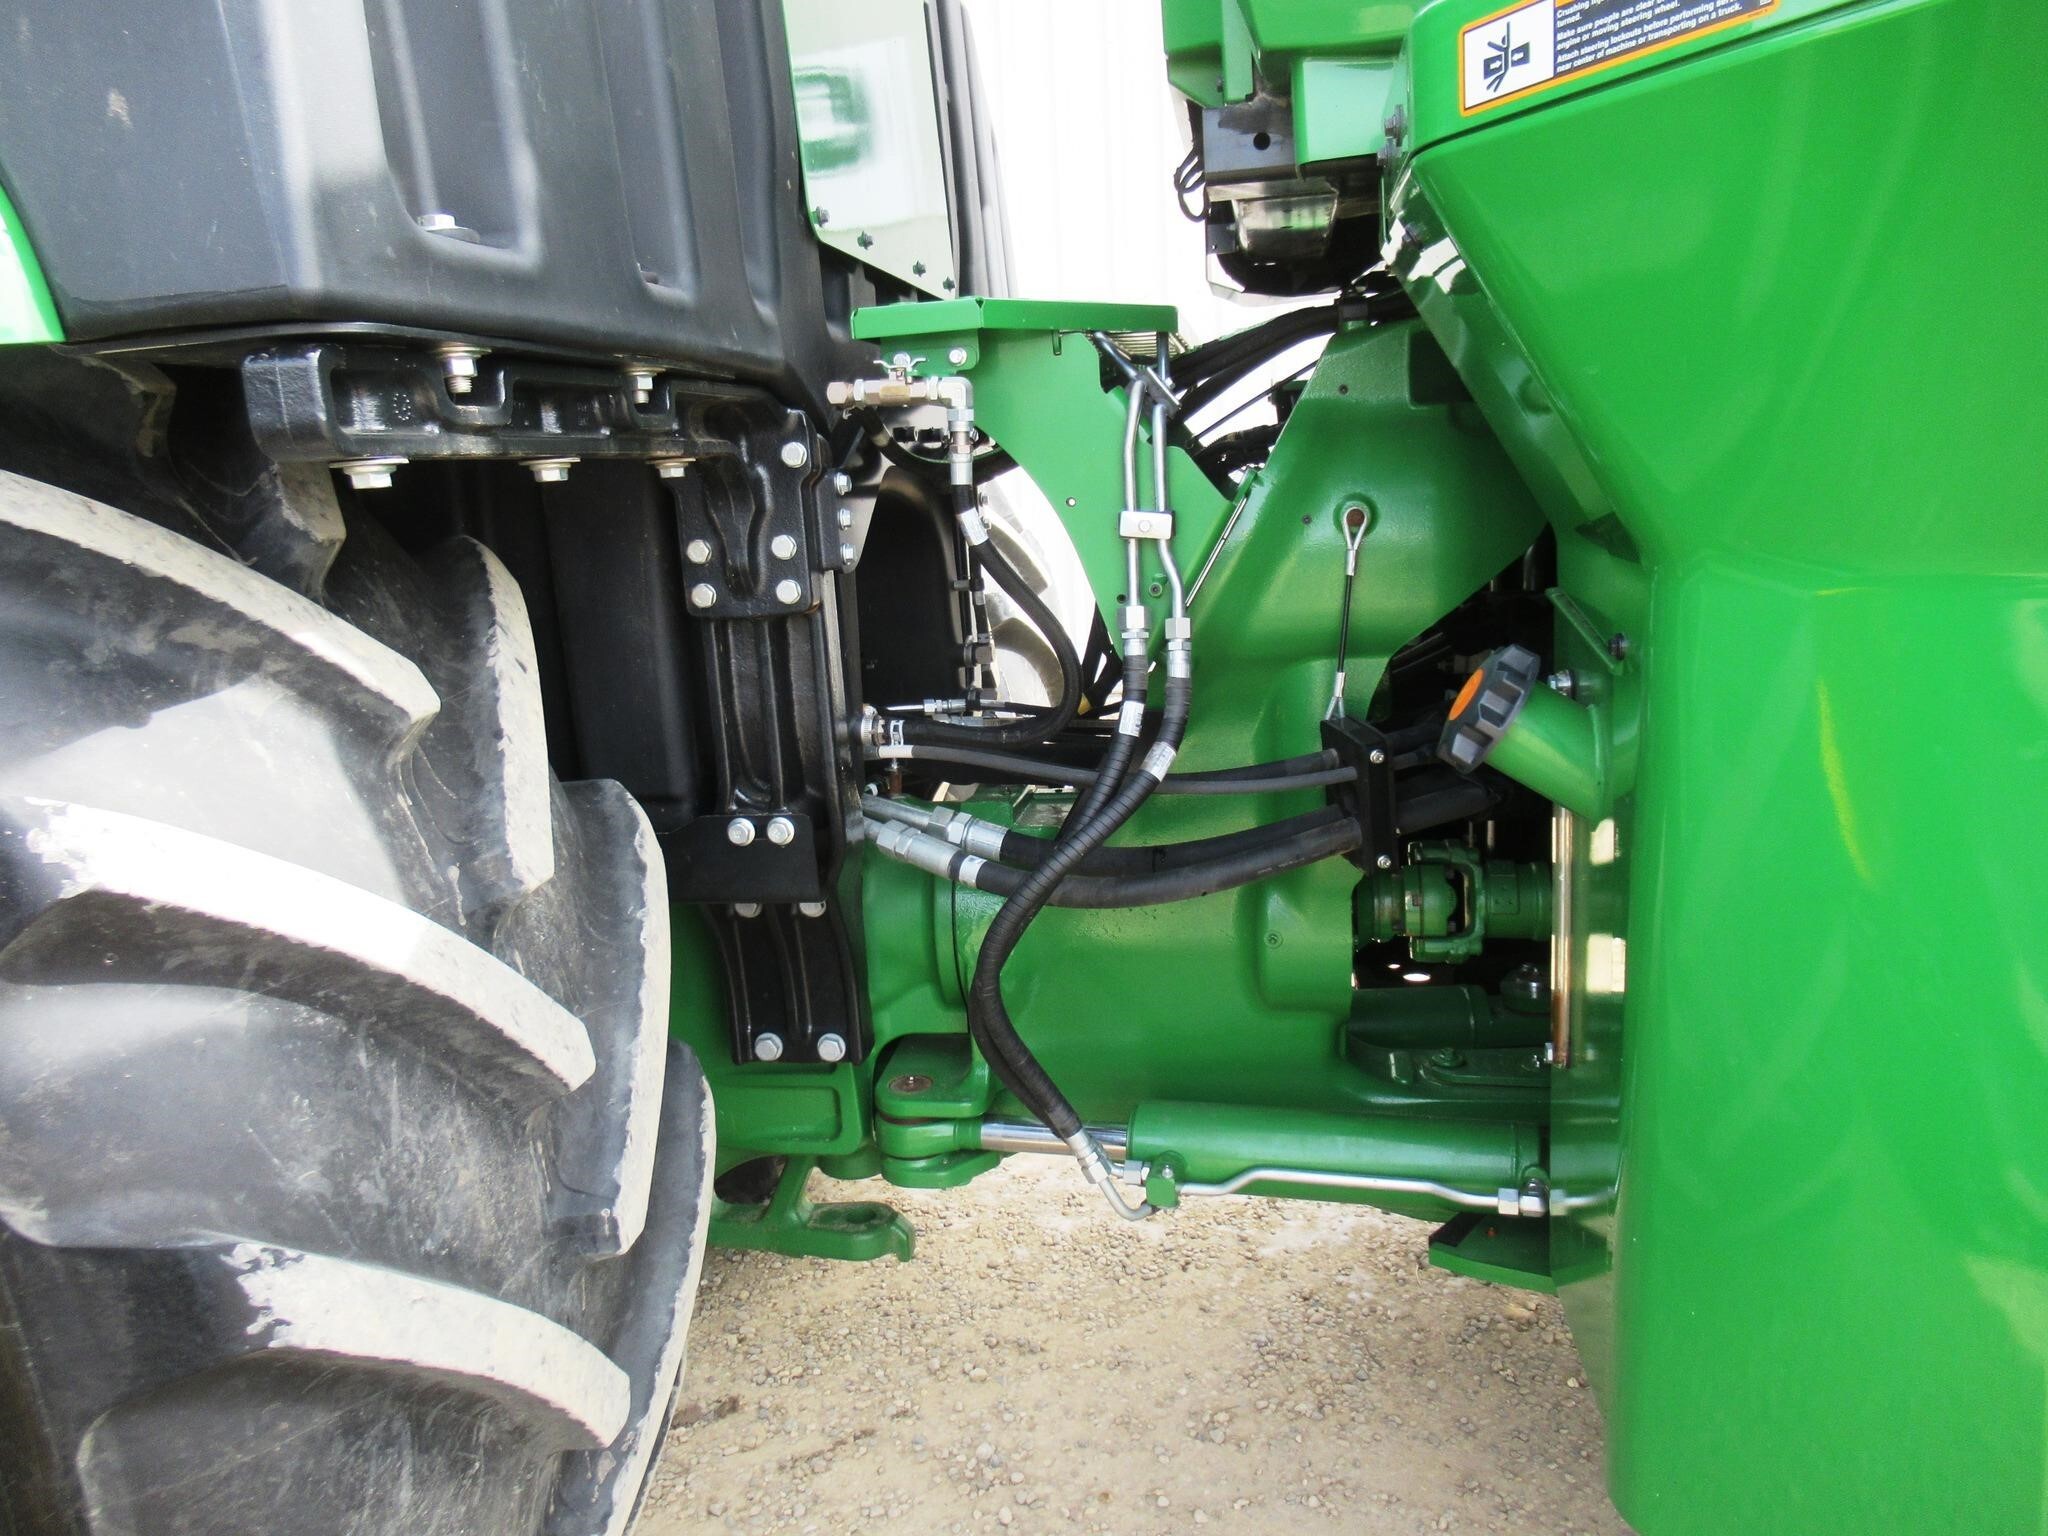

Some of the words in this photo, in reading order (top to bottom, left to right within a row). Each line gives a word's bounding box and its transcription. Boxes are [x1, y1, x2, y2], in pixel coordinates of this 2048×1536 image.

[1557, 1, 1589, 18] Crushing
[1557, 12, 1582, 28] turned.
[1557, 29, 1576, 41] Make
[1577, 22, 1593, 34] sure
[1594, 12, 1620, 29] people
[1621, 7, 1634, 18] are
[1635, 0, 1654, 12] clear
[1557, 36, 1581, 51] engine
[1581, 33, 1591, 41] or
[1591, 22, 1619, 38] moving
[1620, 10, 1652, 28] steering
[1654, 0, 1680, 15] wheel.
[1557, 50, 1579, 63] Attach
[1580, 39, 1609, 56] steering
[1610, 28, 1642, 45] lockouts
[1643, 18, 1668, 33] before
[1669, 2, 1714, 25] performing
[1557, 62, 1572, 73] near
[1573, 54, 1596, 67] center
[1596, 48, 1605, 59] of
[1605, 39, 1637, 56] machine
[1638, 36, 1647, 45] or
[1648, 18, 1697, 41] transporting
[1698, 14, 1709, 23] on
[1718, 3, 1743, 17] truck.
